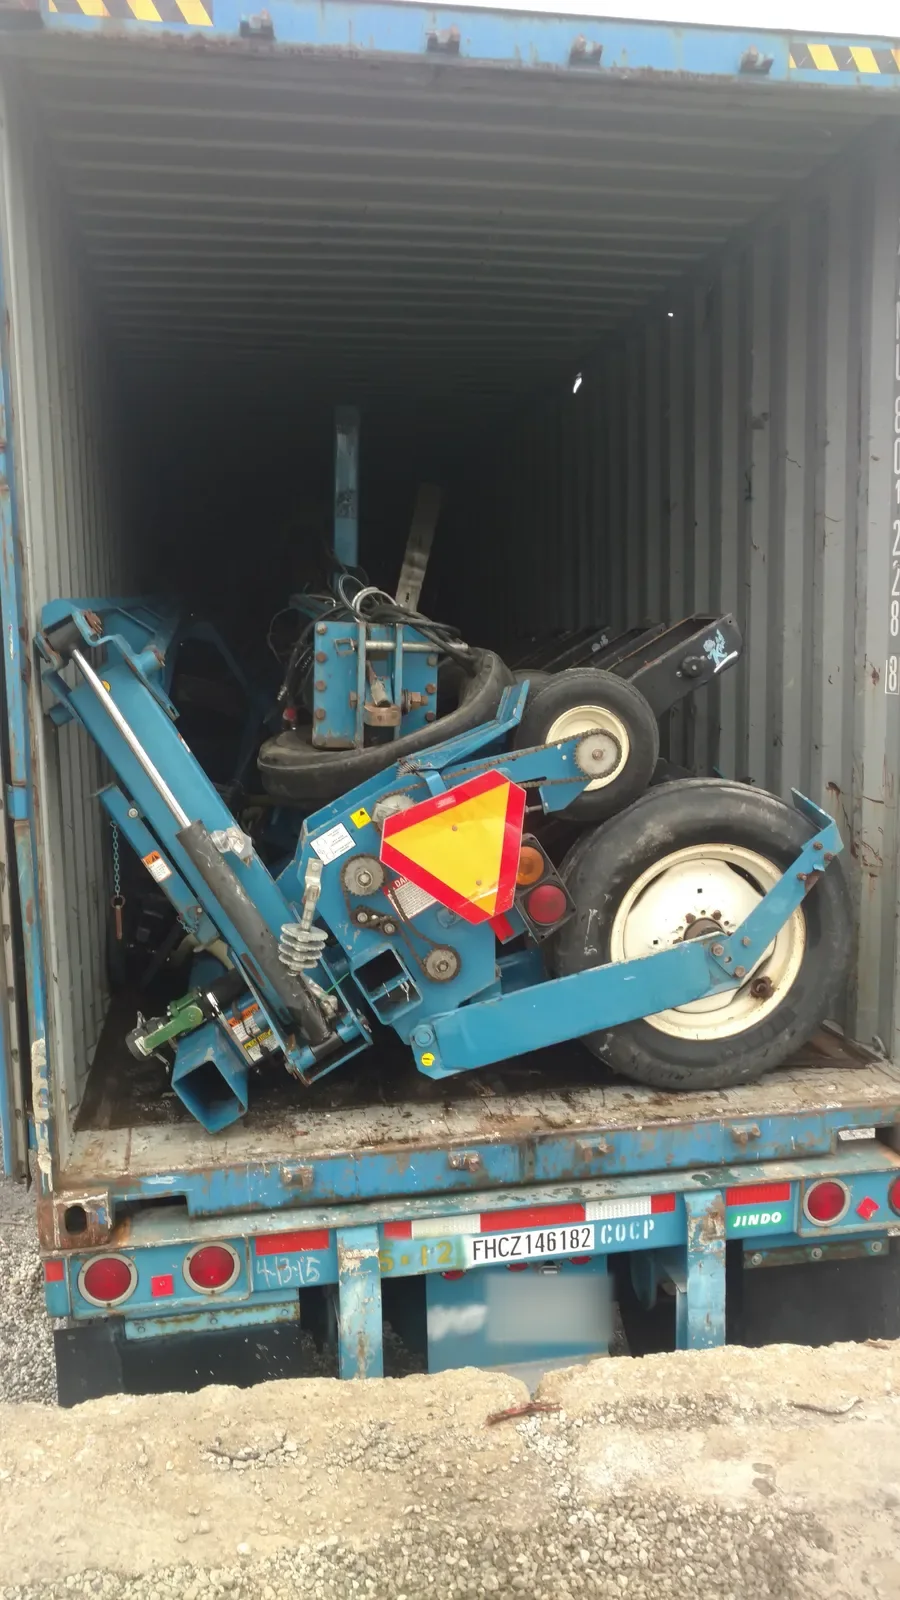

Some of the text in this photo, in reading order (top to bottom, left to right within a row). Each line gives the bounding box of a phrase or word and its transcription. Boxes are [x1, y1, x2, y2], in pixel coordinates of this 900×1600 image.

[601, 1219, 655, 1244] COCP
[733, 1212, 782, 1227] JINDO
[473, 1228, 591, 1260] FHCZ146182
